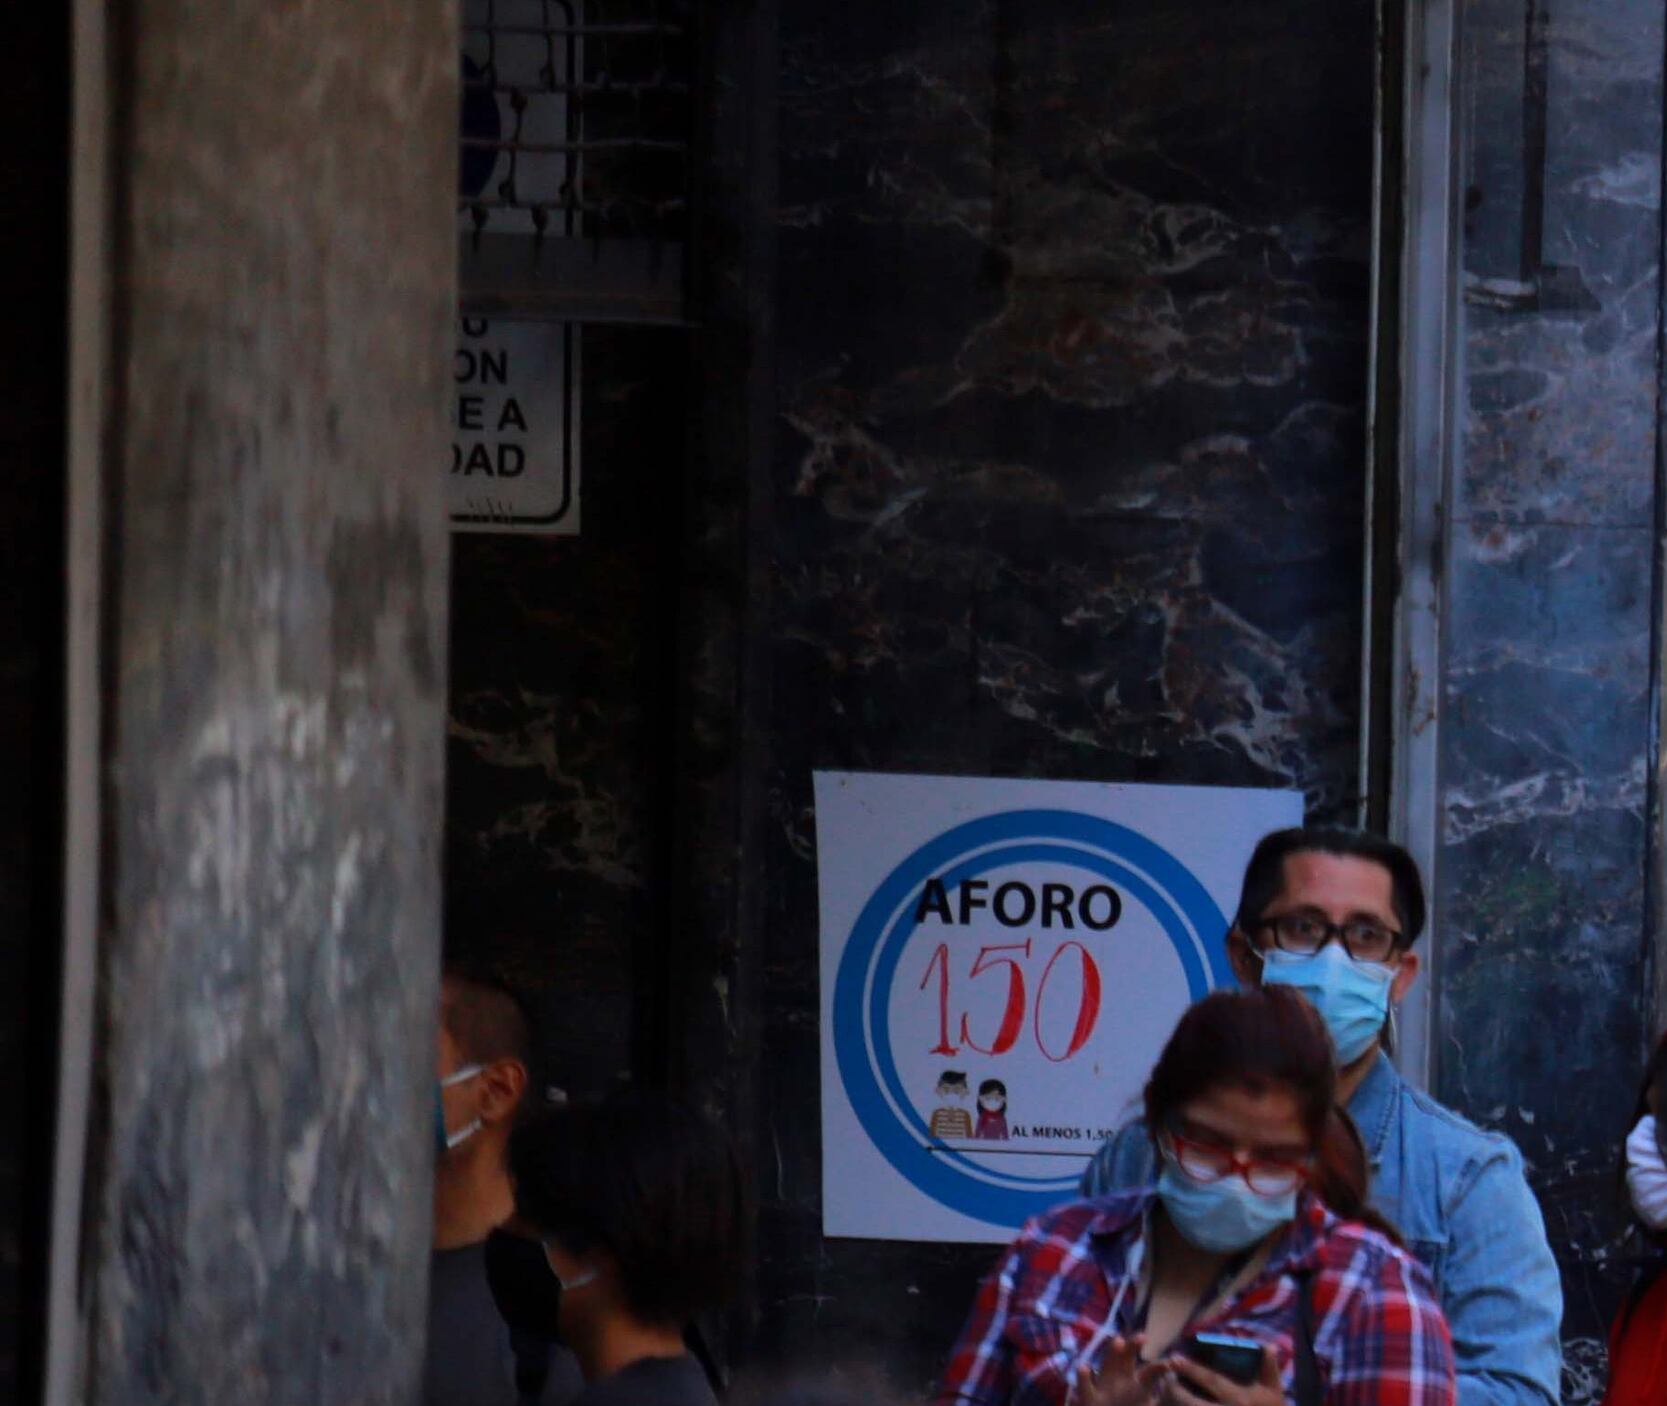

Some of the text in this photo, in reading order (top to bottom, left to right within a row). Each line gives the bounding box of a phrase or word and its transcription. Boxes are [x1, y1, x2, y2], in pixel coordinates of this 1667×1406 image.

[914, 876, 1122, 931] AFORO
[919, 937, 1102, 1063] 150
[1012, 1125, 1028, 1137] AL
[1032, 1126, 1081, 1139] MENOS
